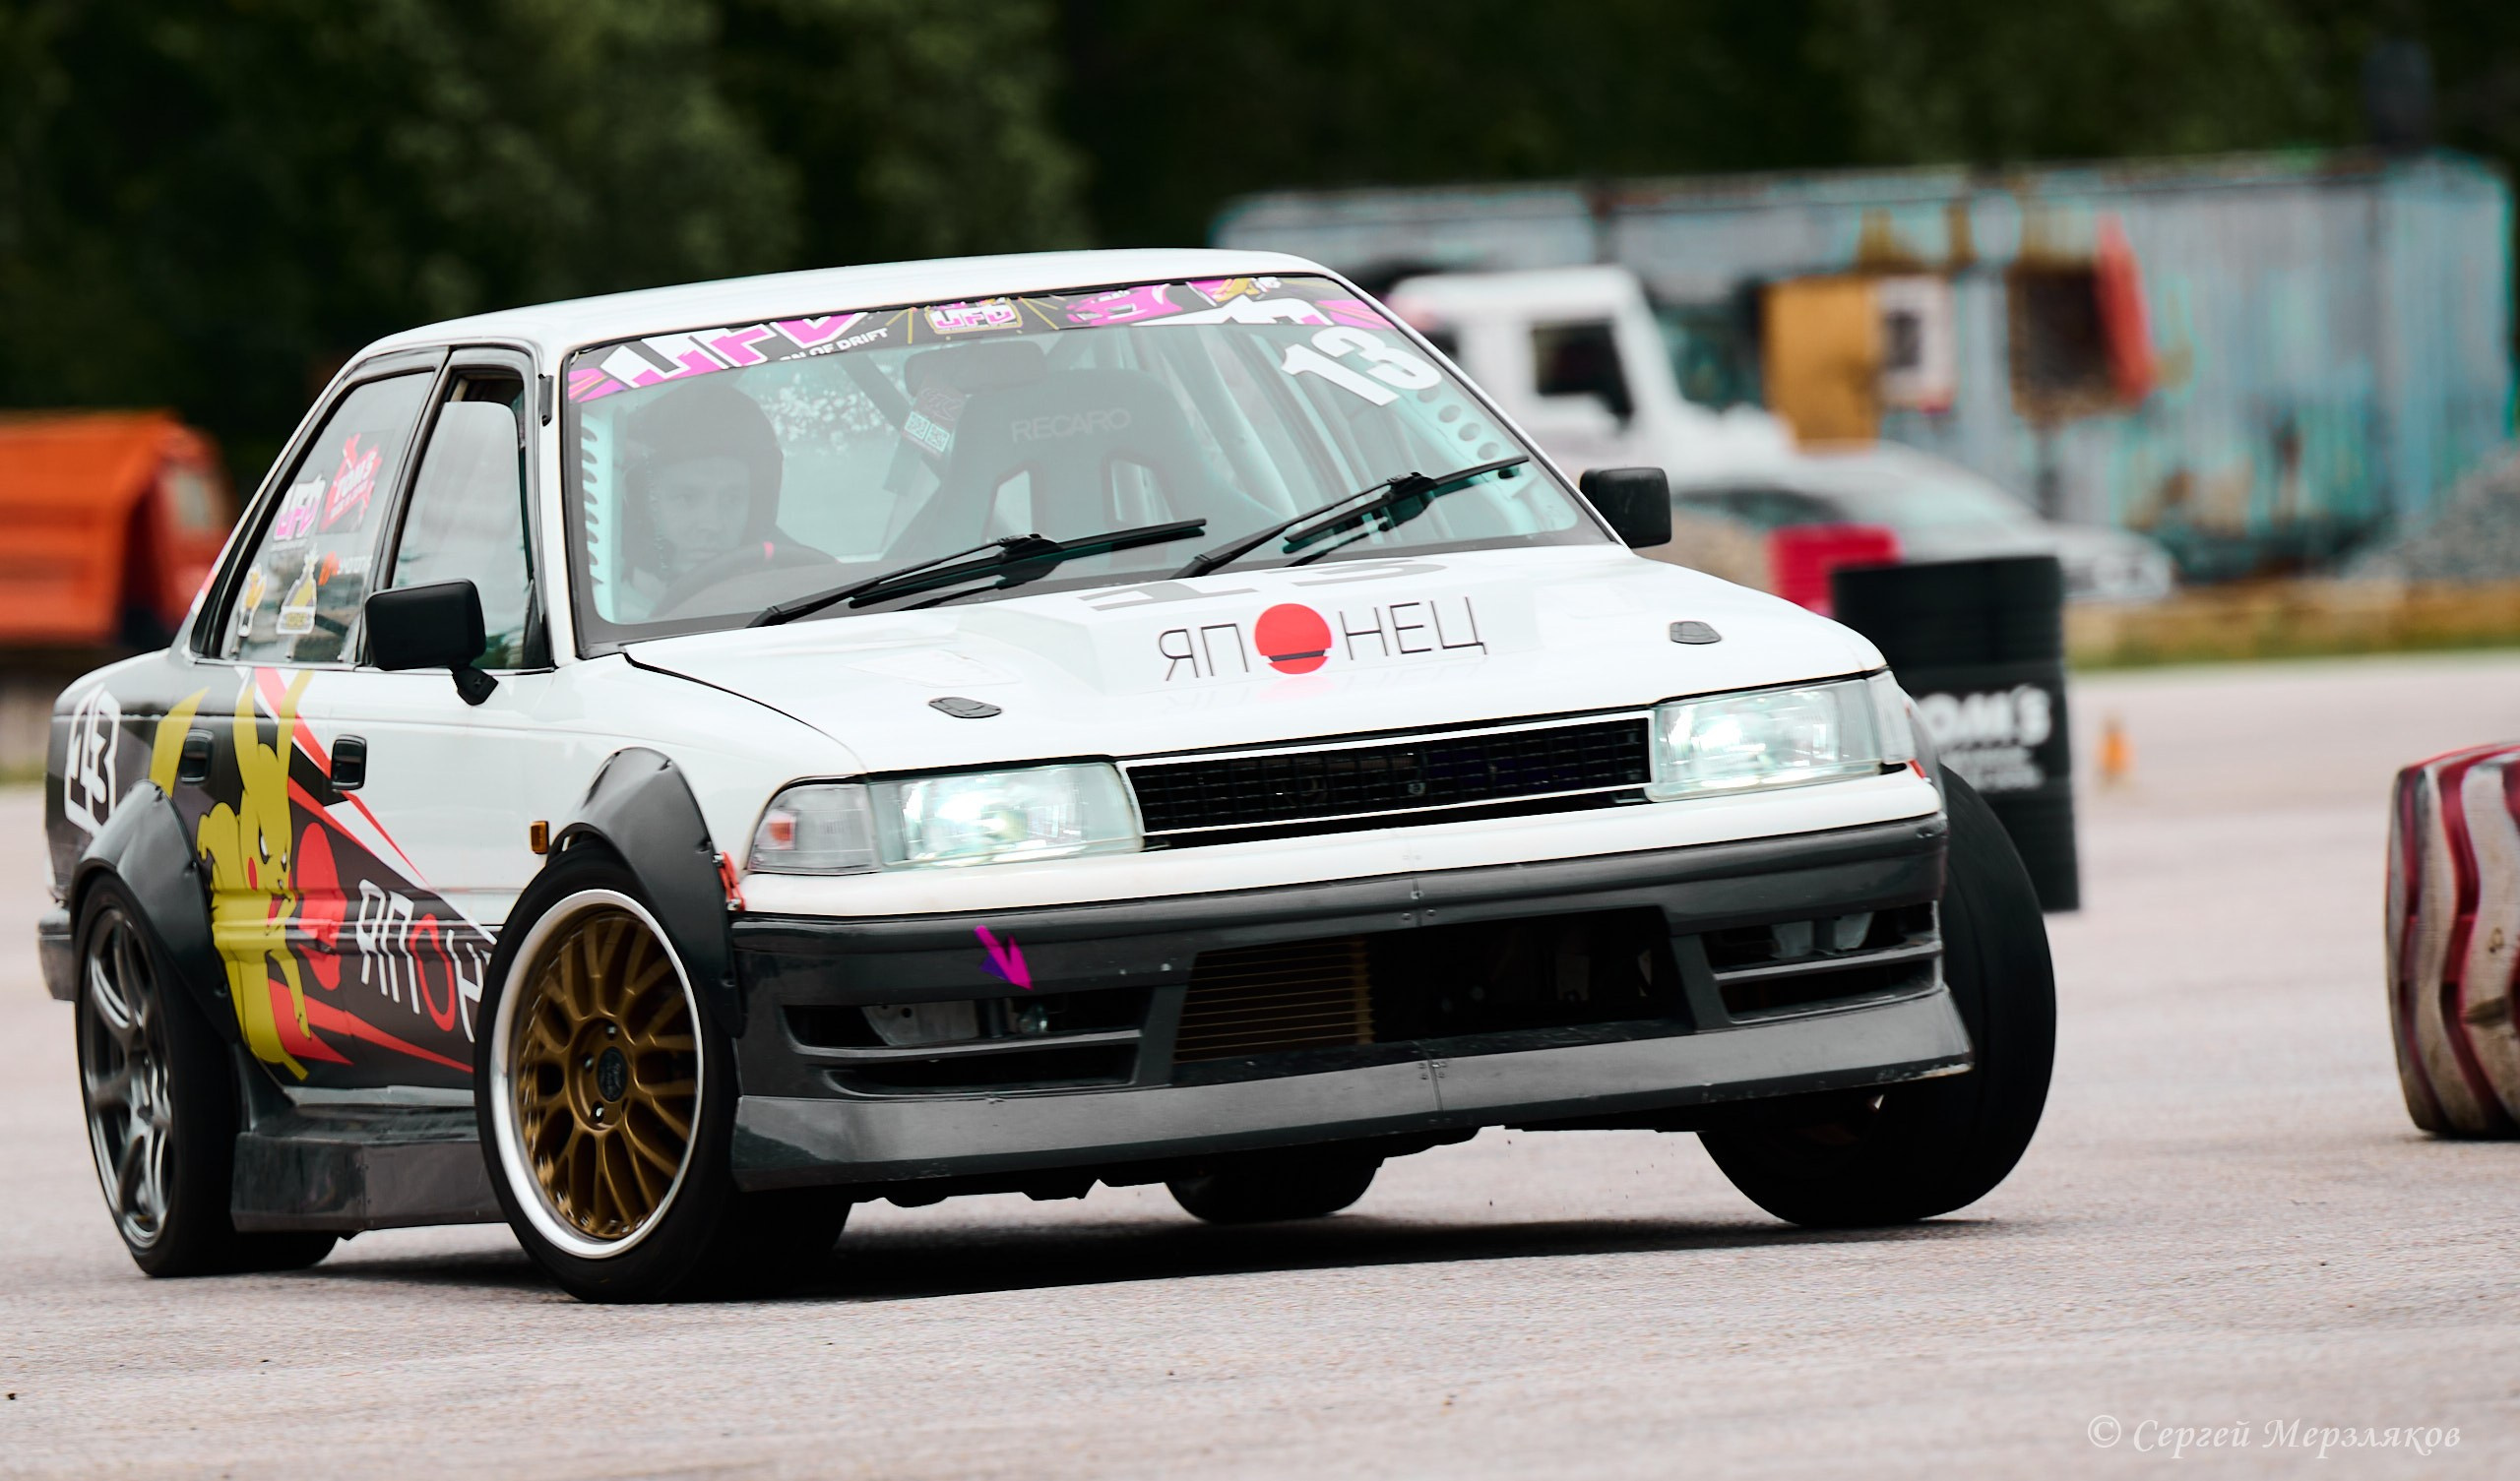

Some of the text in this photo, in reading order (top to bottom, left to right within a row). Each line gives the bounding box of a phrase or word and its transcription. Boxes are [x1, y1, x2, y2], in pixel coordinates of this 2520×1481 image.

[836, 327, 888, 351] DRIFT
[1281, 325, 1443, 406] 13
[1011, 407, 1132, 444] RECARO
[355, 879, 492, 1043] ЯПОН
